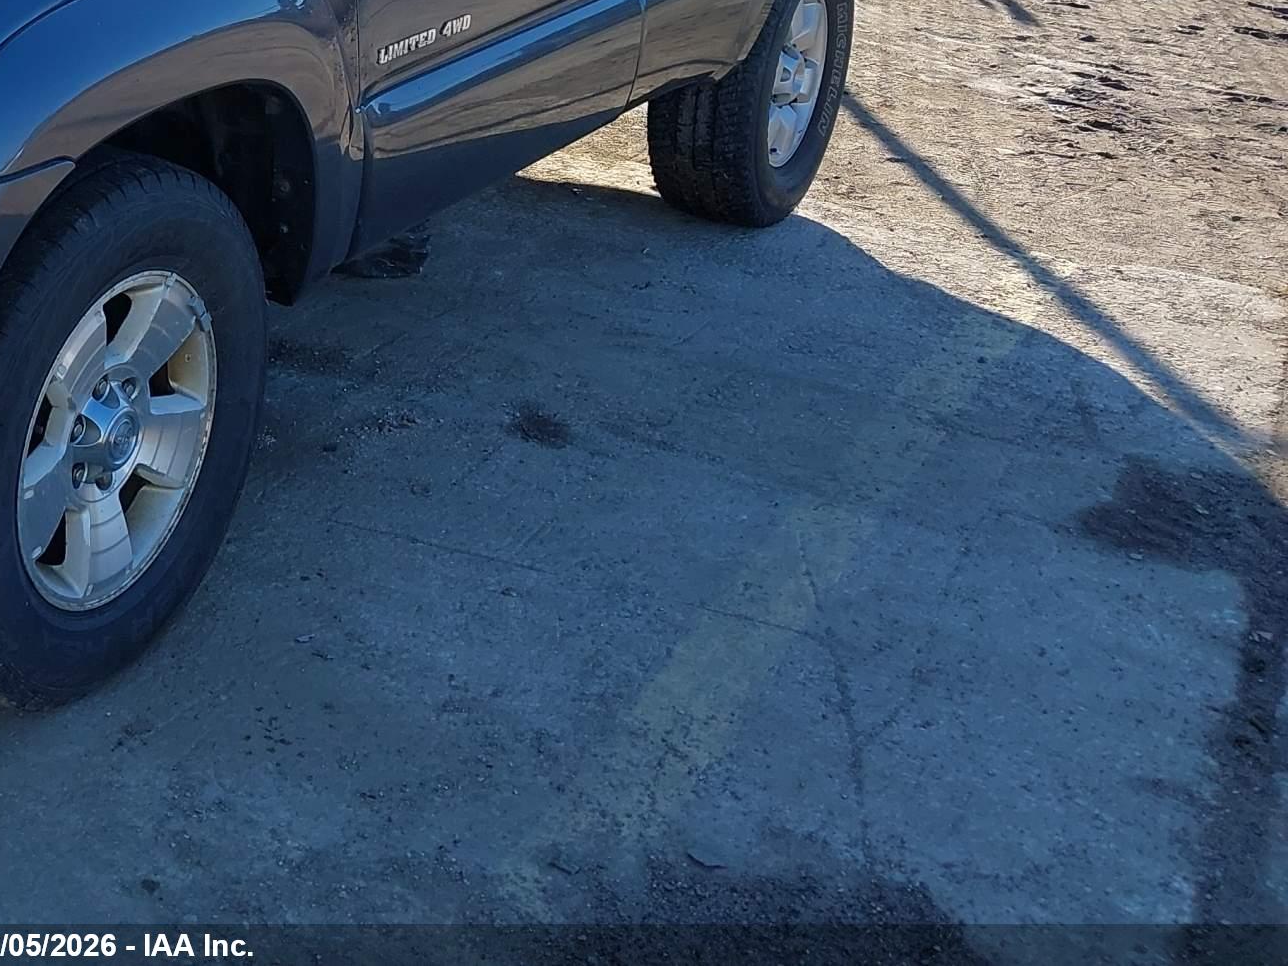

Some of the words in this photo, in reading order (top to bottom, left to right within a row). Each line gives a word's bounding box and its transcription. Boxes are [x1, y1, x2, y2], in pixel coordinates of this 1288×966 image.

[377, 28, 437, 65] LIMITED
[441, 13, 472, 37] 4WD
[817, 2, 849, 137] MICHELIN
